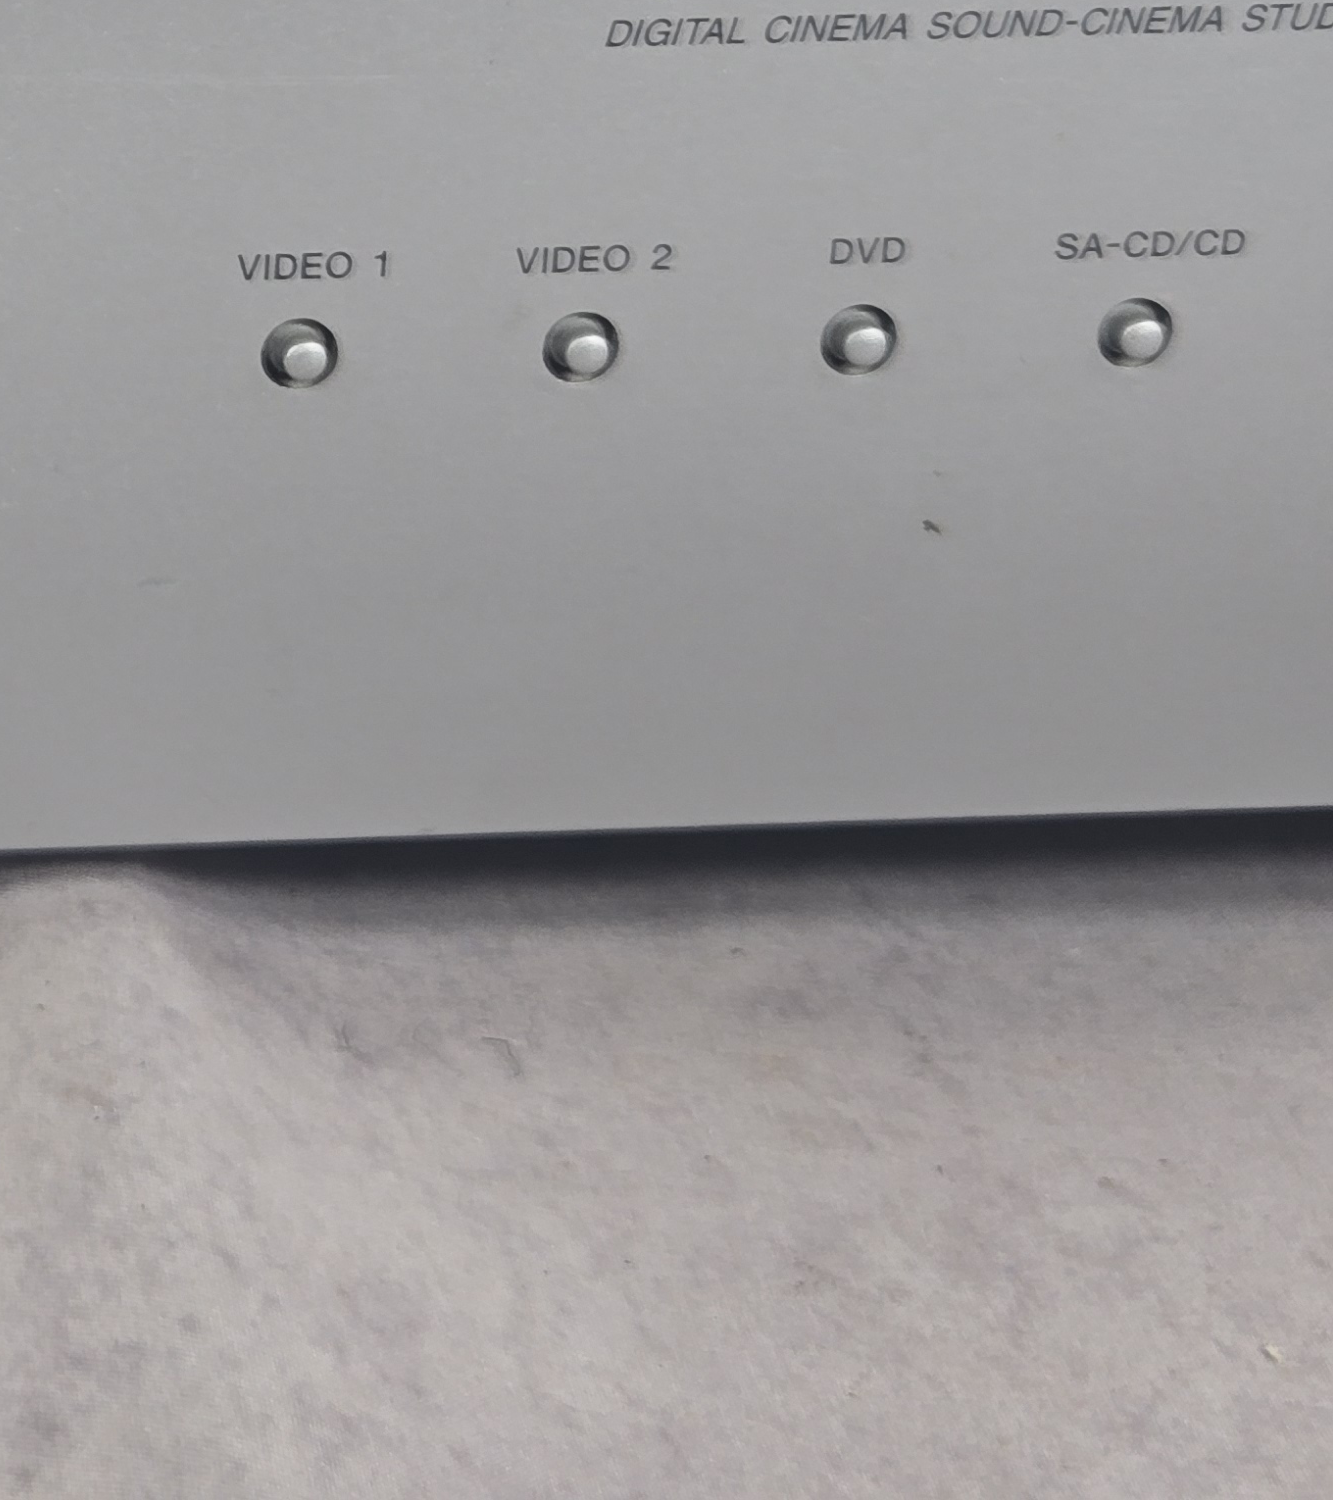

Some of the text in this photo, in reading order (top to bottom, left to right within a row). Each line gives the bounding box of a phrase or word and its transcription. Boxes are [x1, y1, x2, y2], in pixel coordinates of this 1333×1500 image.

[603, 15, 747, 49] DIGITAL
[763, 11, 909, 45] CINEMA
[925, 4, 1225, 41] SOUND-CINEMA
[515, 242, 674, 276] VIDEO 2
[828, 235, 907, 266] DVD
[1053, 227, 1247, 262] SA-CD/CD
[236, 249, 389, 282] VIDEO 1
